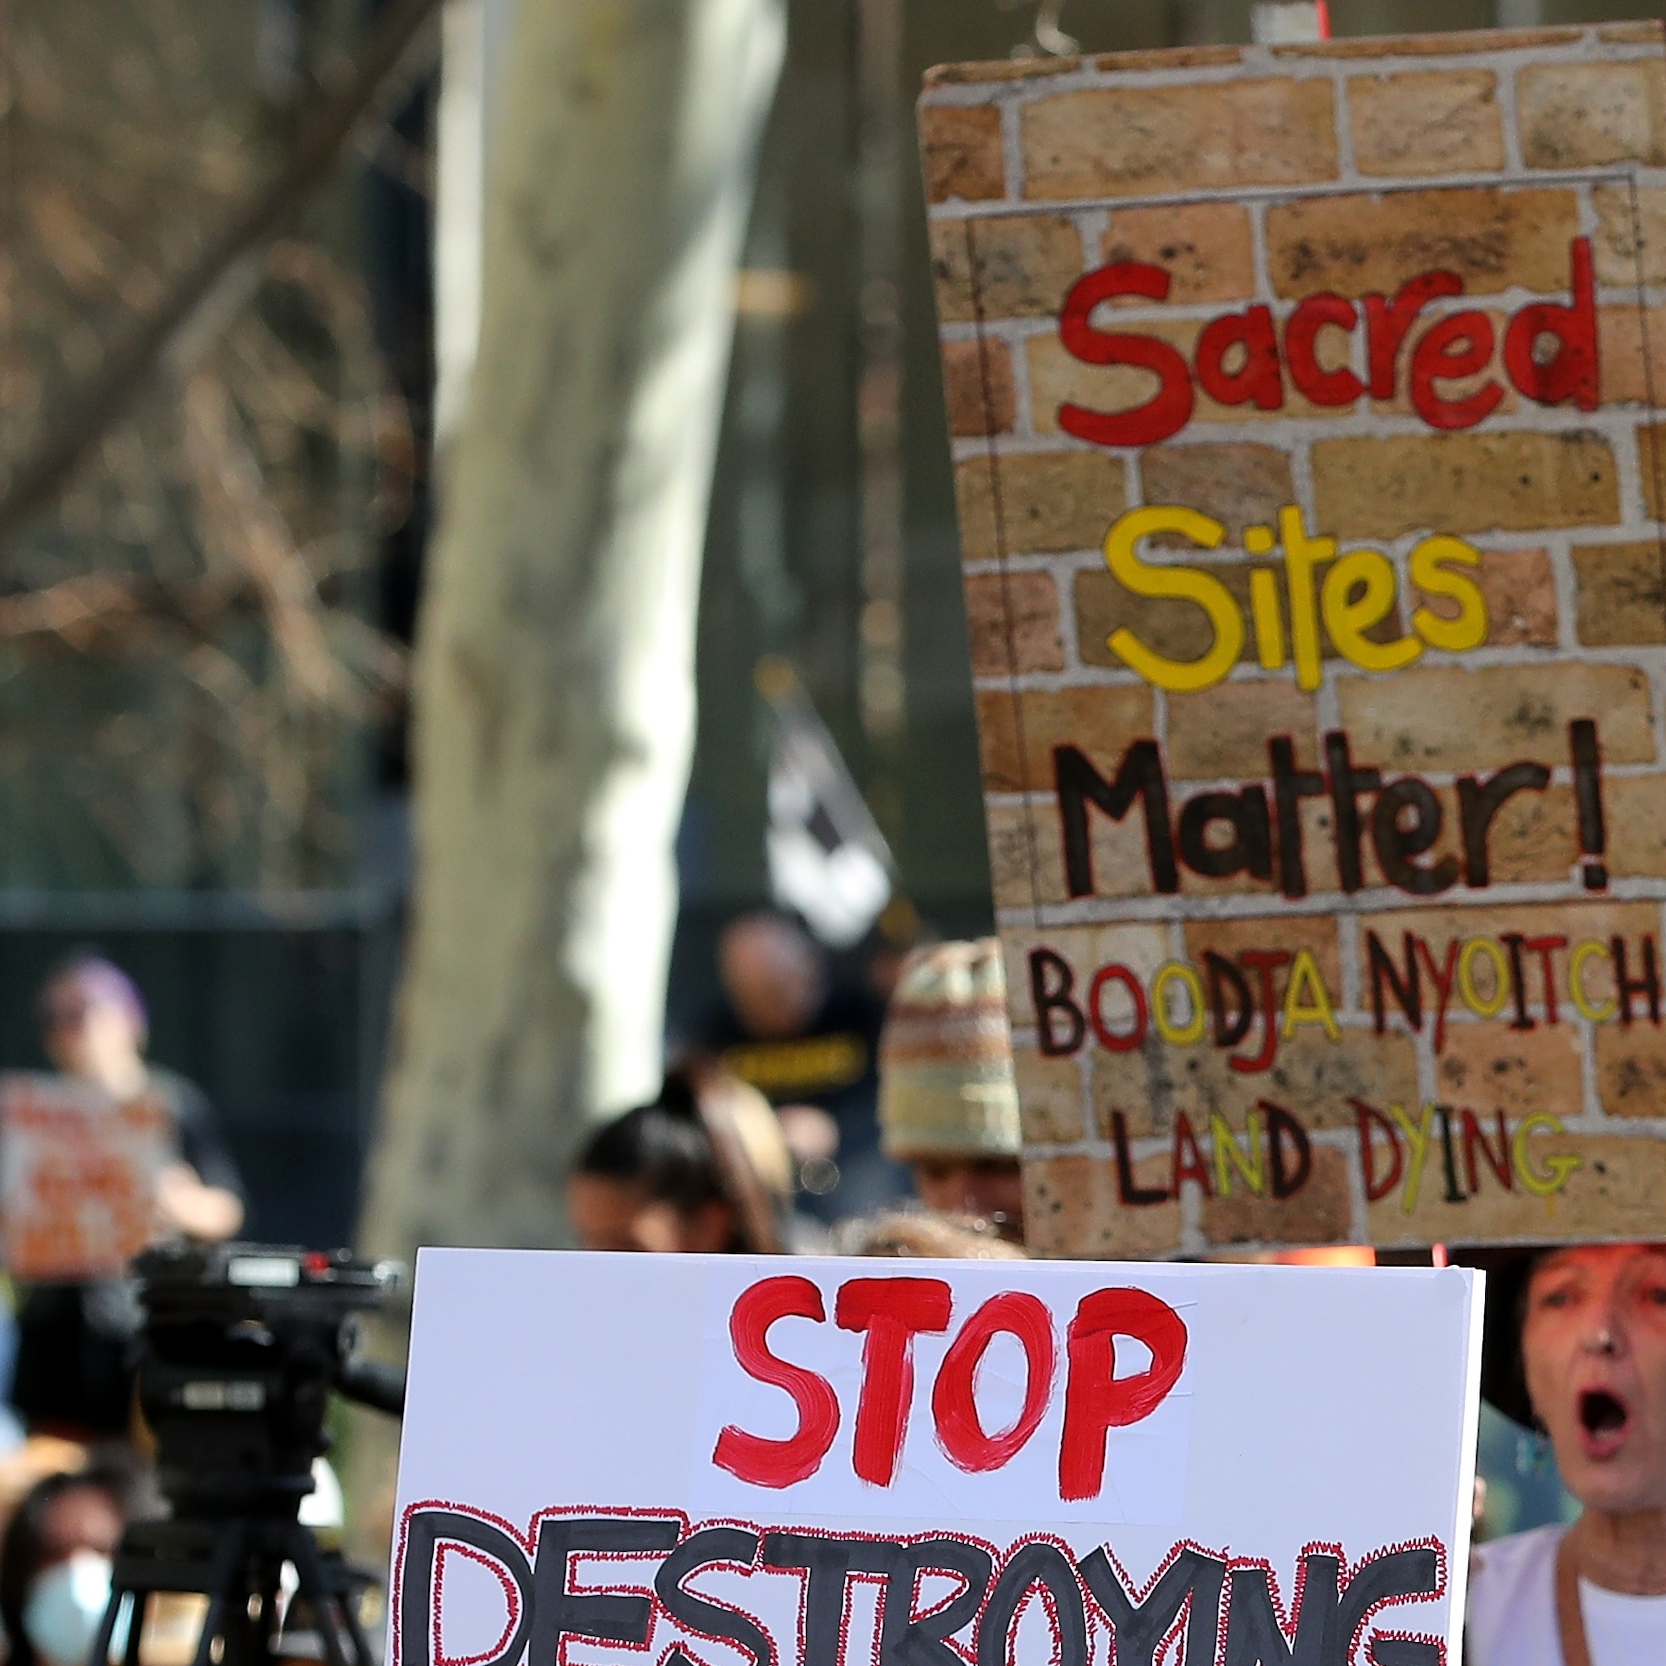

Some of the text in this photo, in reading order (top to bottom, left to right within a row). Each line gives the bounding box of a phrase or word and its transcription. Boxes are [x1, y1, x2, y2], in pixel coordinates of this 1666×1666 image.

[1058, 237, 1600, 446] Sacred
[1103, 504, 1488, 692] Sites
[1053, 718, 1611, 899] Matter!
[1028, 931, 1665, 1074] BOODJA NYOITCH
[1109, 1097, 1583, 1214] LAND DYING
[712, 1276, 1188, 1502] STOP
